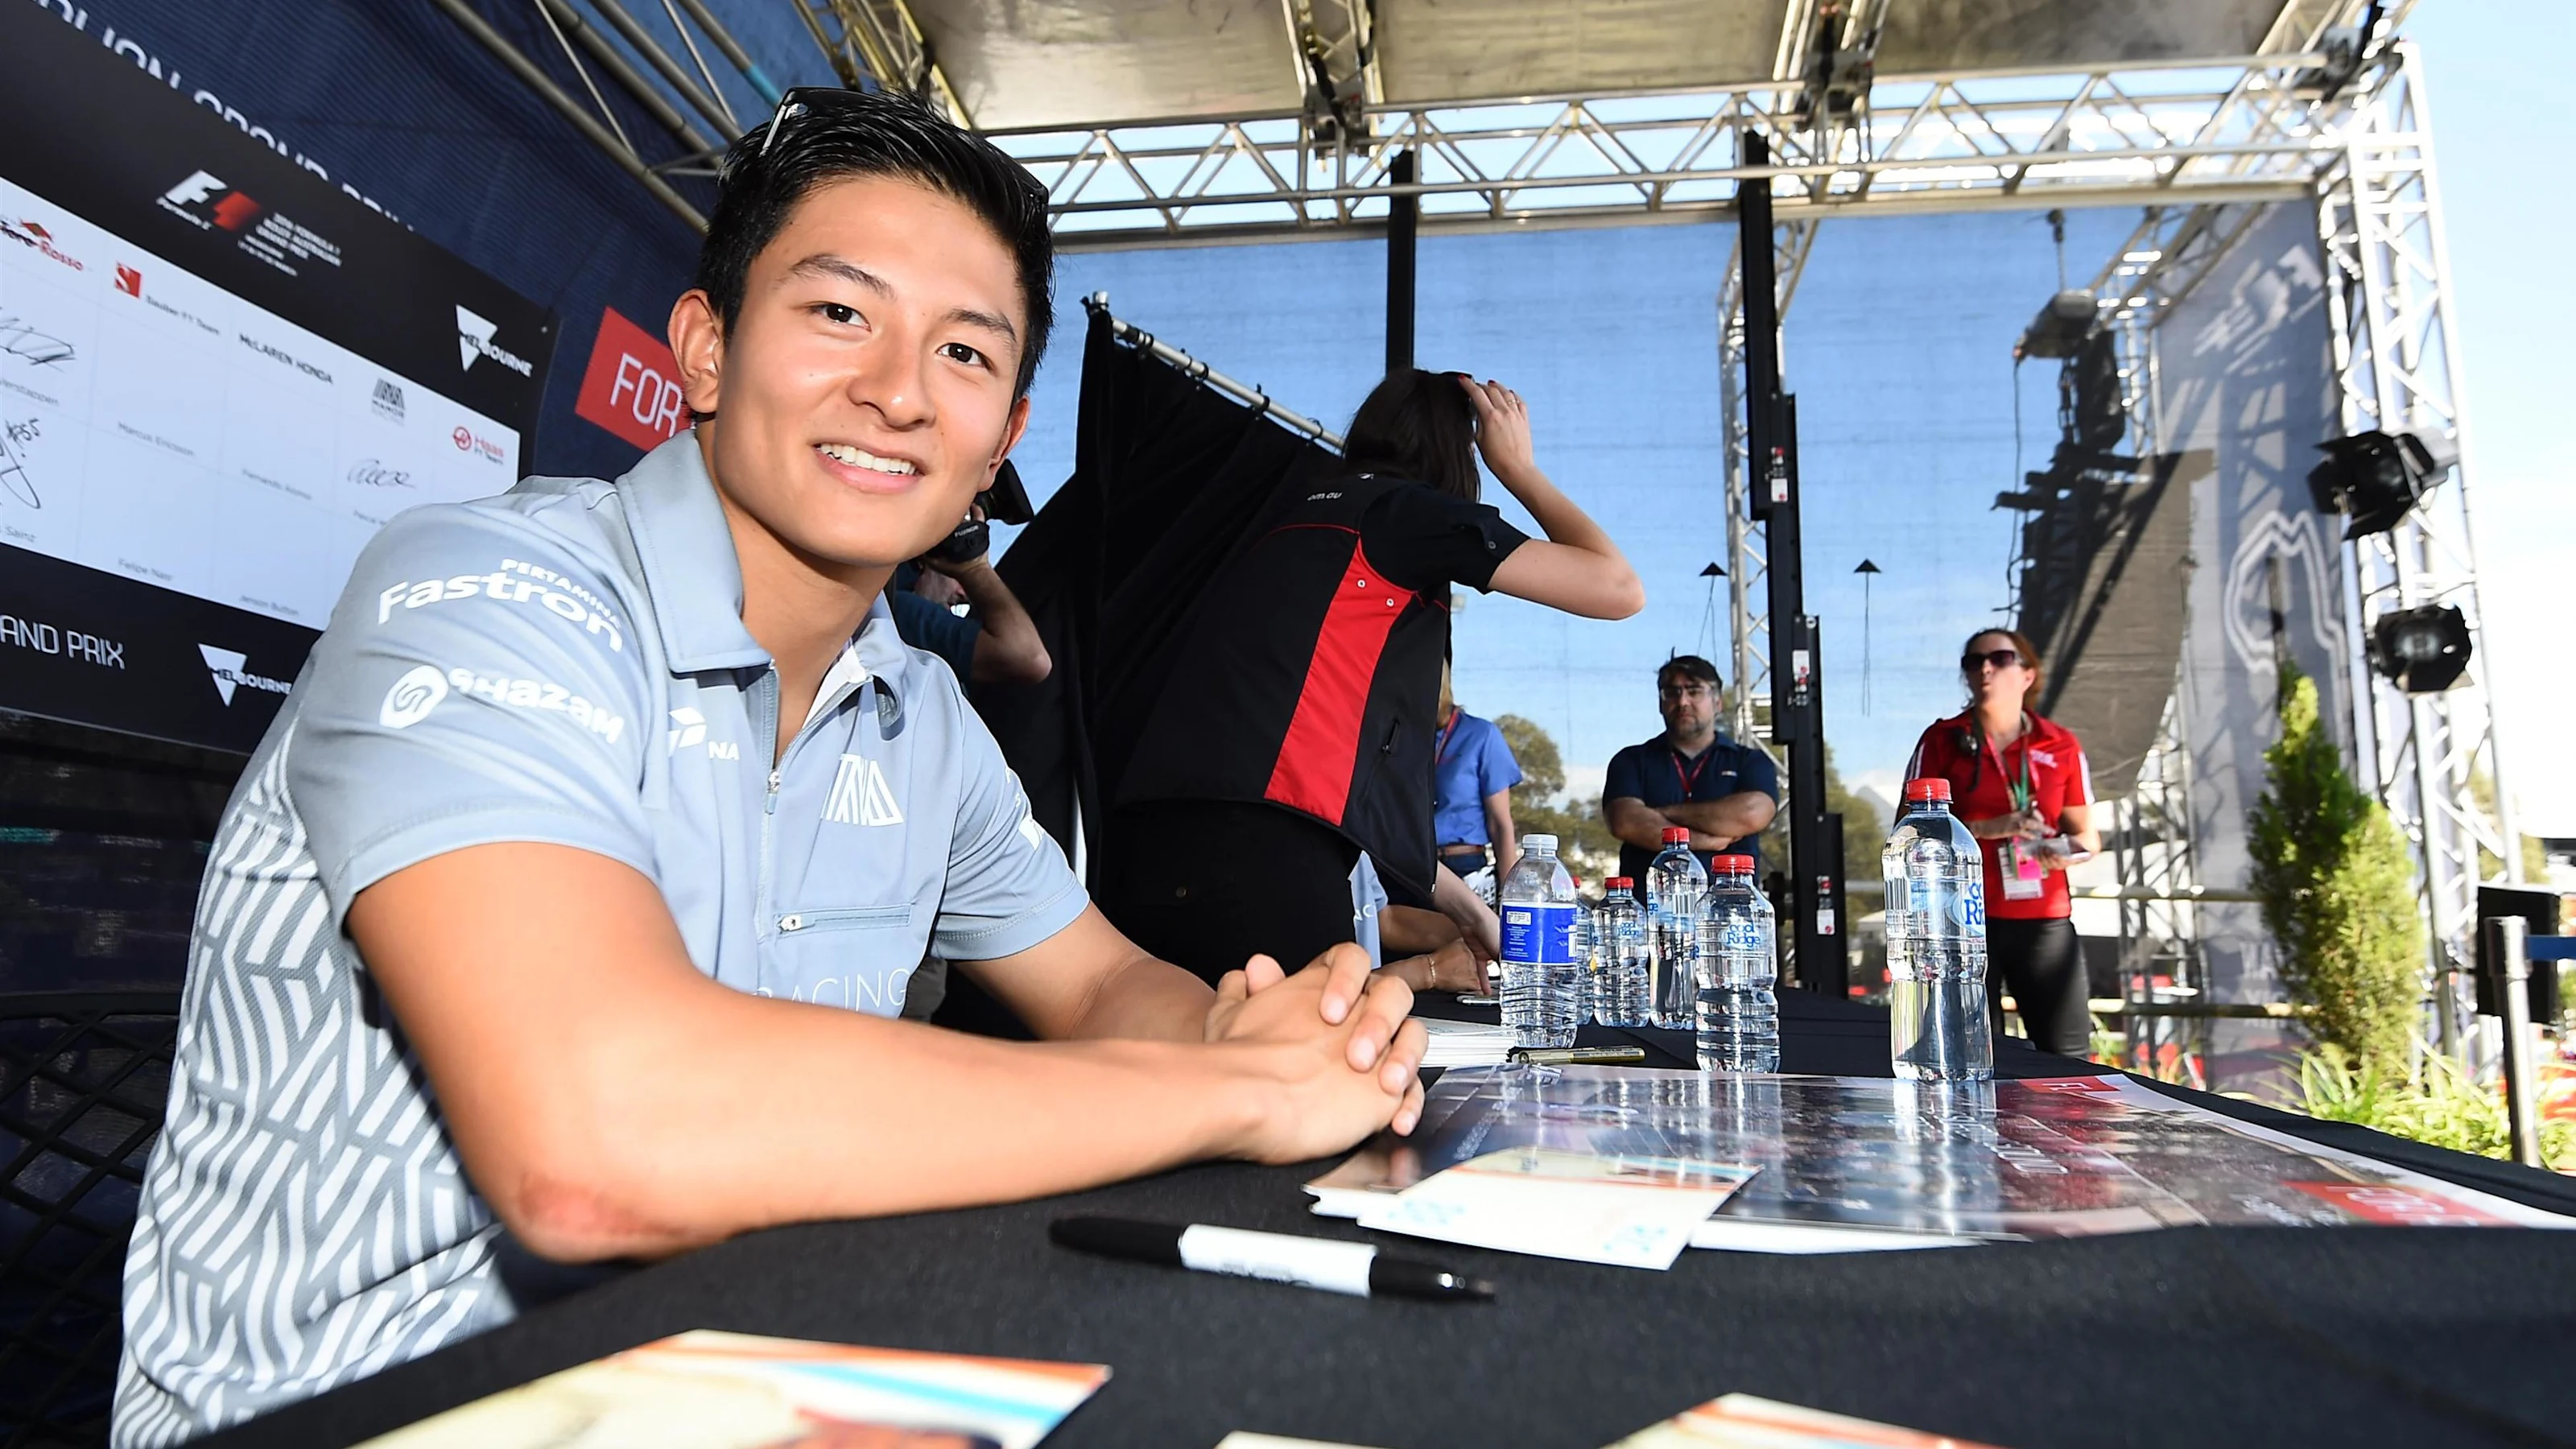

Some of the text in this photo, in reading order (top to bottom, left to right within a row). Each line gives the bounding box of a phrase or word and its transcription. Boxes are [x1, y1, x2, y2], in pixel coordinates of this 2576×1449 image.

[610, 352, 683, 439] FOR
[378, 572, 623, 653] Fastron
[500, 559, 622, 629] PERTAMINA
[67, 630, 125, 670] PRIX
[1726, 932, 1761, 947] Ridge
